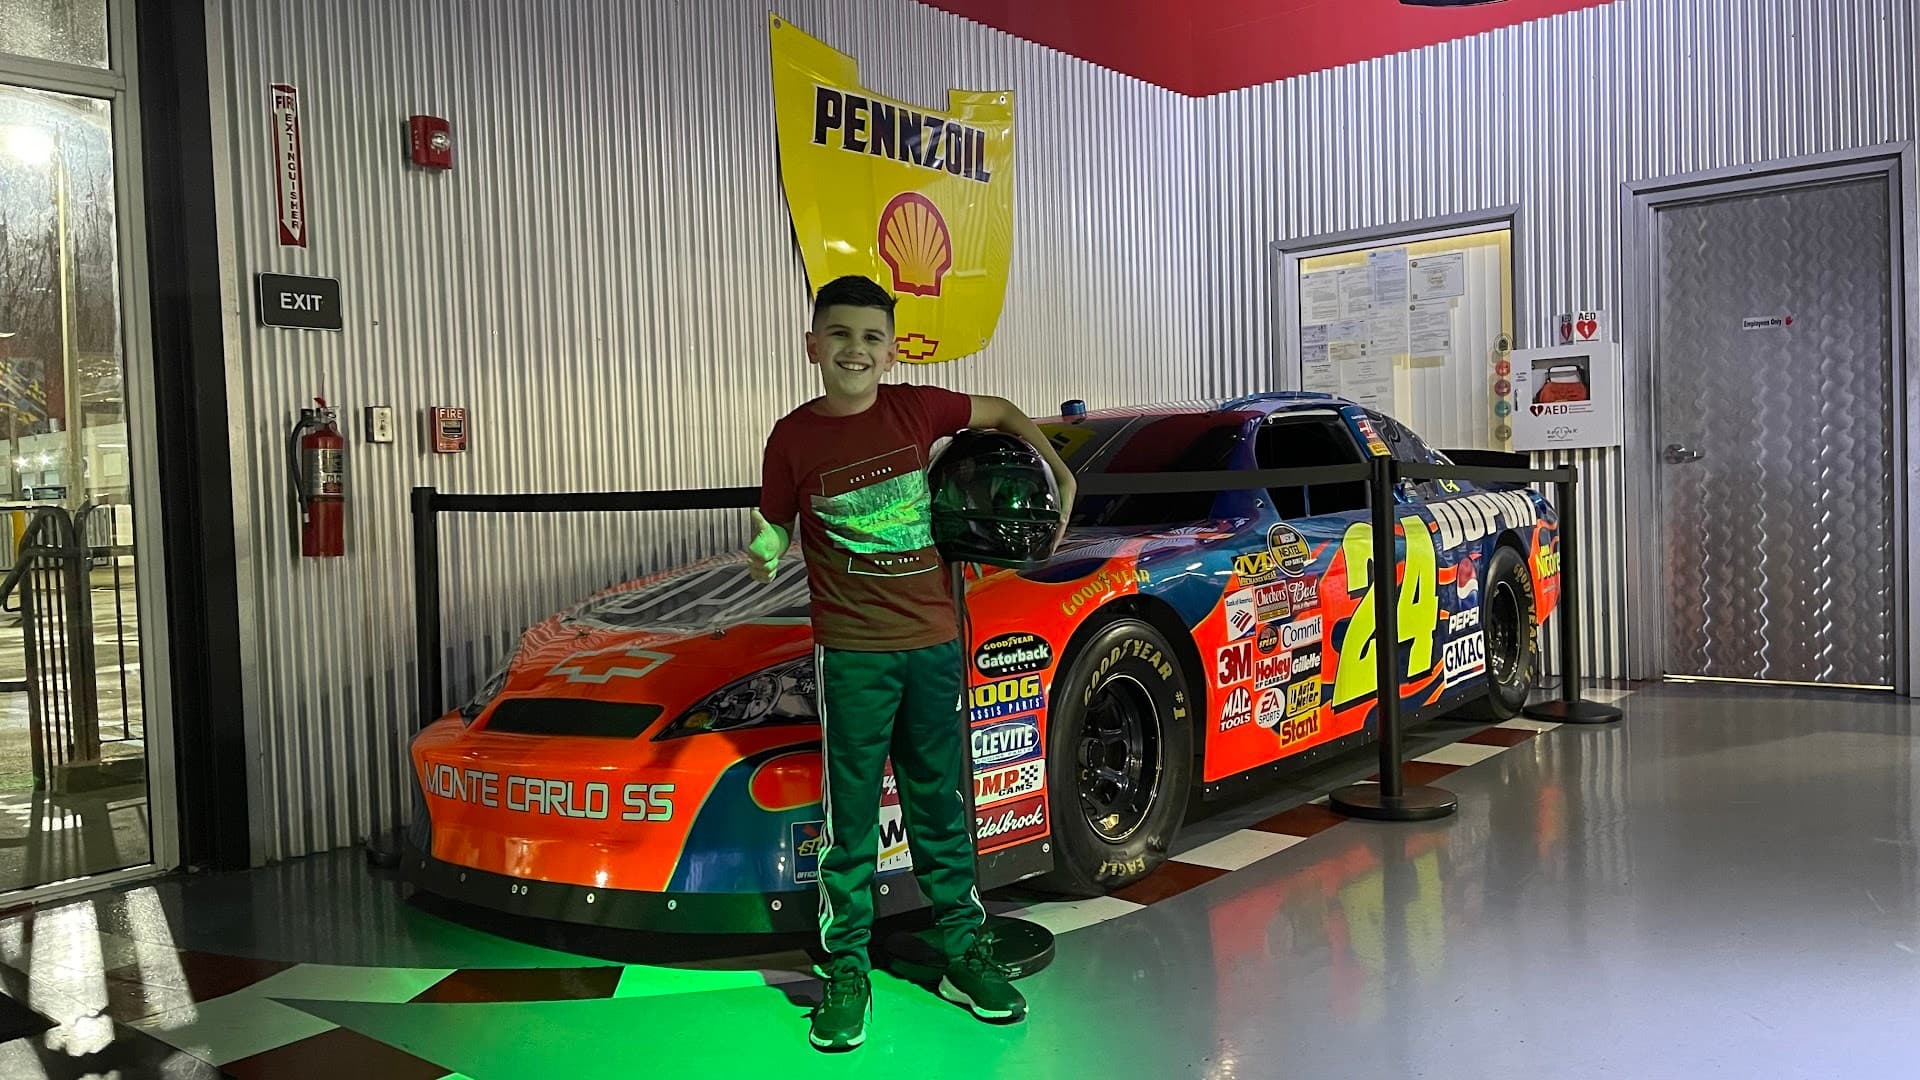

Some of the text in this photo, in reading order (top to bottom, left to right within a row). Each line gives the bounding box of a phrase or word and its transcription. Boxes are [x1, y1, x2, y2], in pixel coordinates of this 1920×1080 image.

[275, 95, 295, 112] FIR
[812, 85, 991, 184] PENNZOIL
[285, 113, 300, 230] EXTINGUISHER
[280, 292, 323, 311] EXIT
[1561, 314, 1572, 323] AED
[1578, 312, 1596, 321] AED
[440, 408, 464, 419] FIRE
[1544, 404, 1568, 415] AED
[1426, 489, 1537, 551] DUPONT
[1062, 568, 1150, 617] GOODYEAR
[1256, 586, 1286, 607] Checkers
[1288, 579, 1318, 603] Bud
[1331, 514, 1439, 708] 24
[1448, 606, 1480, 634] PEPSI
[983, 635, 1034, 651] GOODYEAR
[1258, 637, 1278, 649] SPEED
[1282, 617, 1321, 648] Commit
[977, 644, 1049, 670] Gatorback
[1219, 642, 1252, 685] 3M
[1292, 653, 1320, 675] Gillette
[1445, 635, 1484, 673] GMAC
[1002, 662, 1037, 673] BELTS
[1083, 638, 1186, 721] GOODYEAR #1
[1255, 656, 1291, 682] Holley
[1008, 698, 1040, 714] PARTS
[1221, 687, 1252, 720] MAC
[1260, 690, 1280, 714] EA
[1220, 712, 1251, 732] TOOLS
[1258, 710, 1281, 725] SPORTS
[1281, 710, 1319, 746] Stant
[971, 725, 1033, 759] CLEVITE
[425, 761, 675, 821] MONTE CARLO SS
[998, 783, 1033, 797] CAMS
